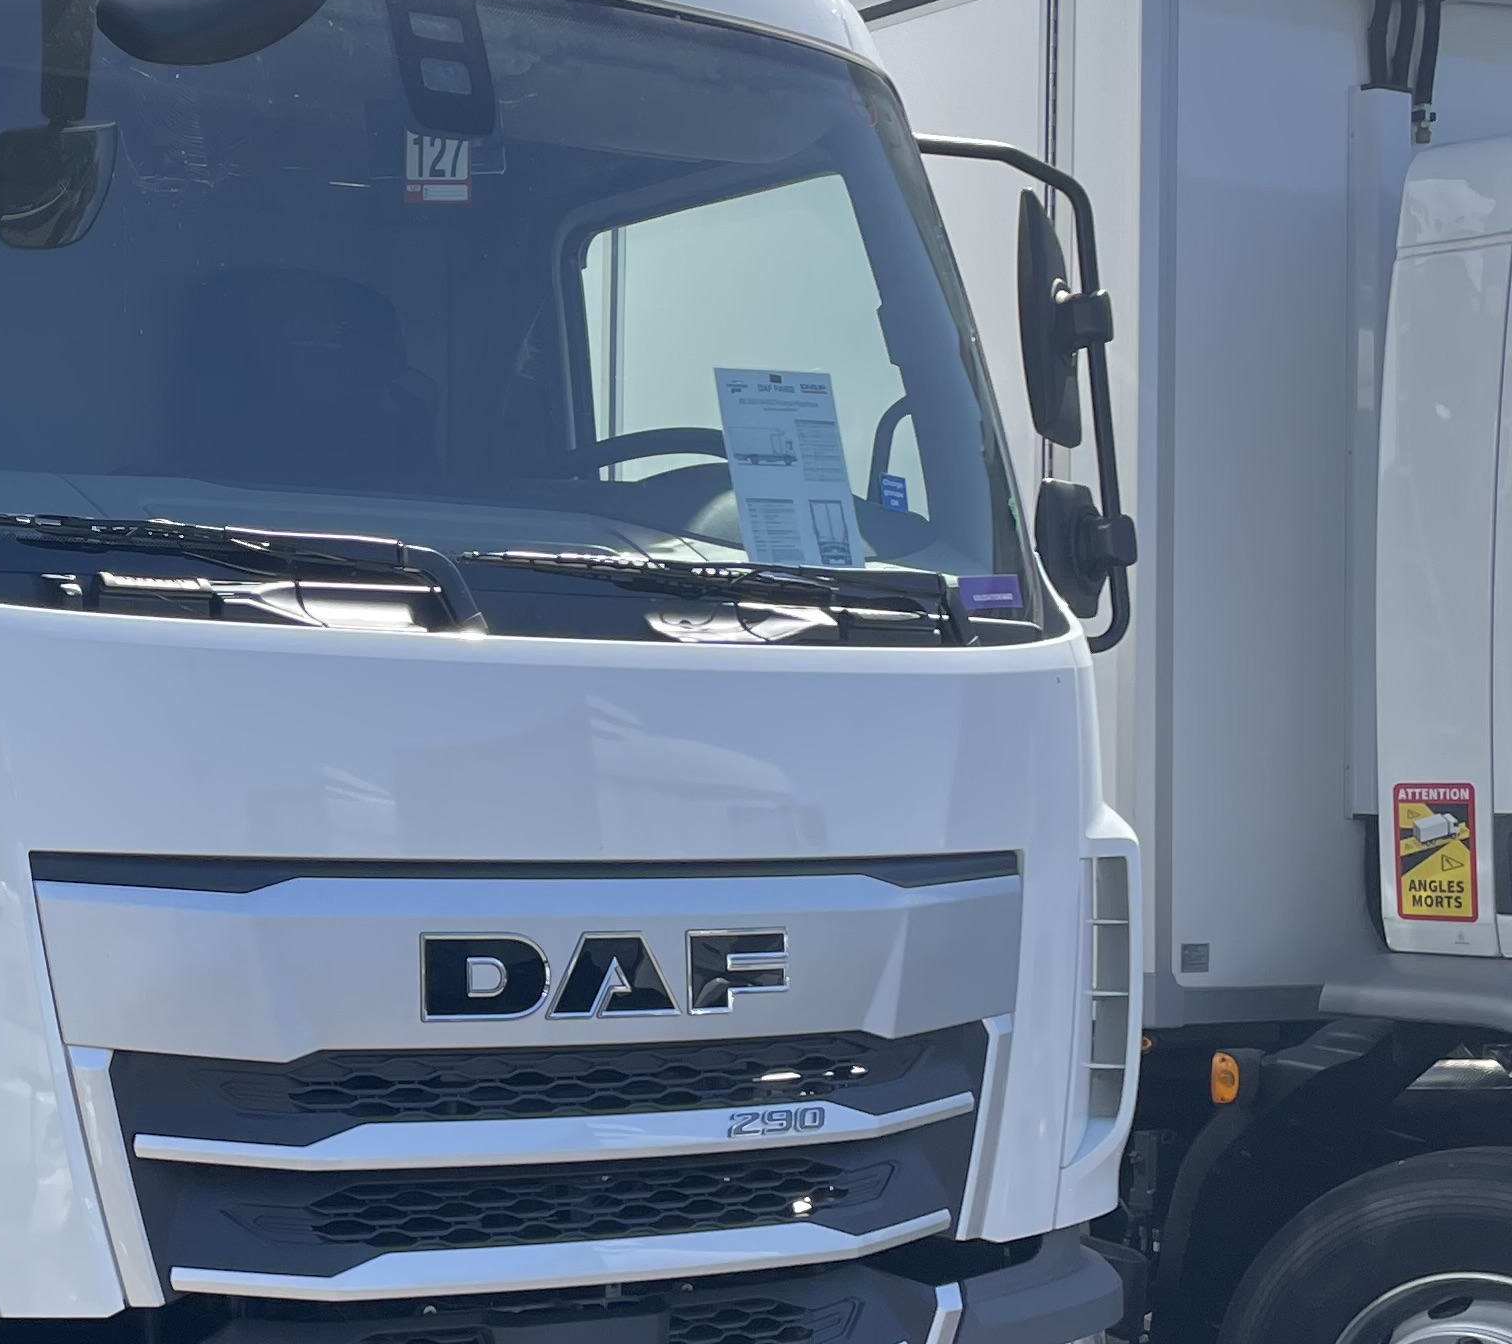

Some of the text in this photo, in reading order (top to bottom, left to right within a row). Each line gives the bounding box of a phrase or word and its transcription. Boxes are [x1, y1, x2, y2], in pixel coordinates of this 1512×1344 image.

[412, 135, 469, 178] 127
[1398, 787, 1470, 801] ATTENTION
[1408, 879, 1465, 894] ANGLES
[1412, 894, 1463, 909] MORTS
[419, 927, 789, 1022] DAF
[727, 1106, 826, 1138] 290
